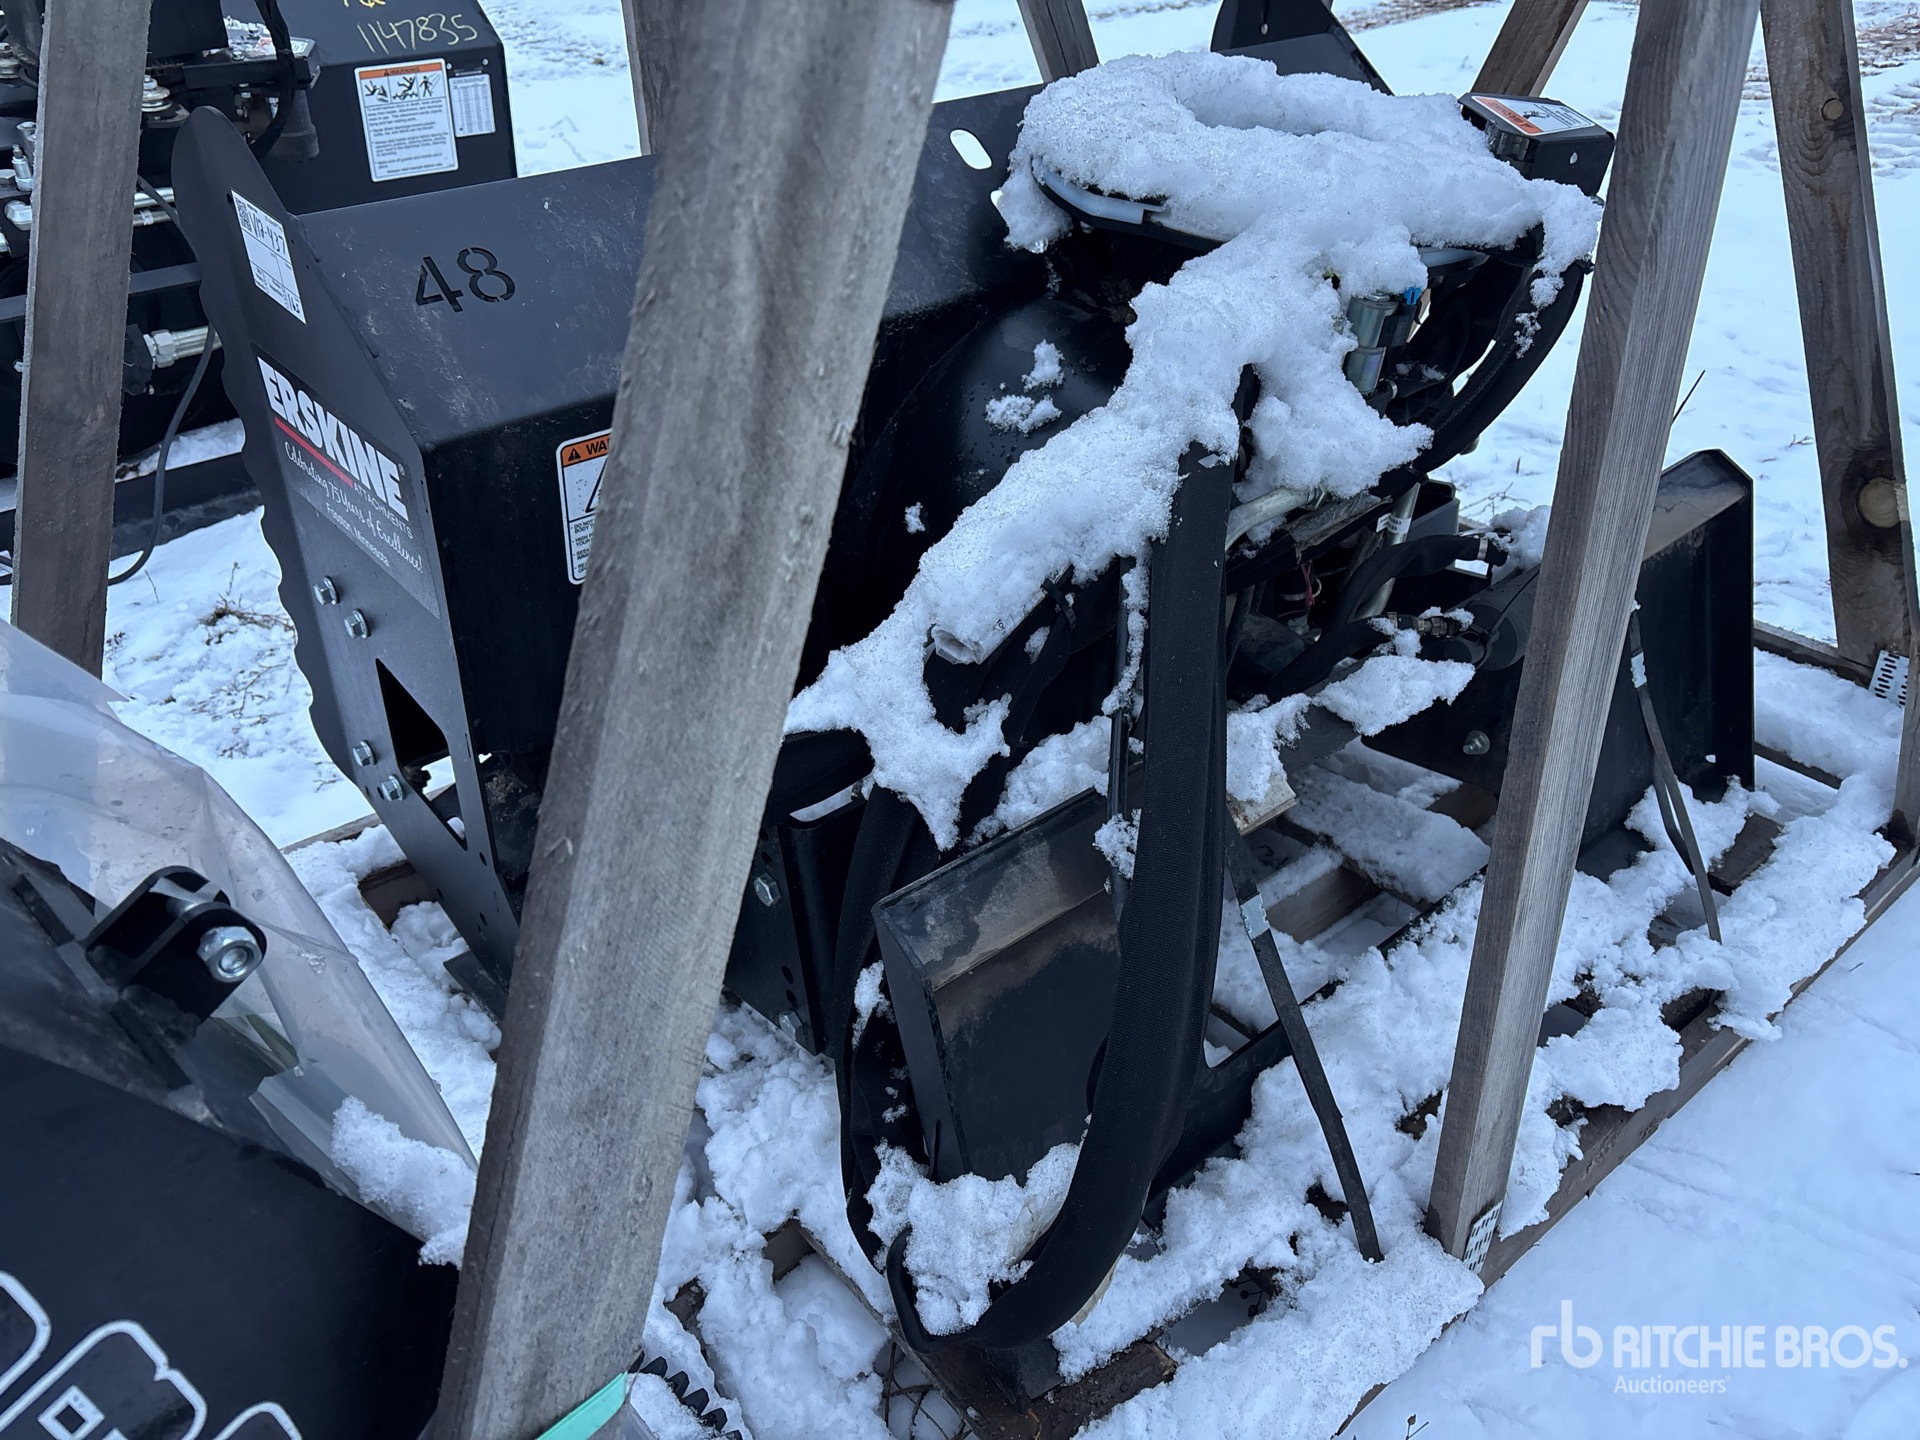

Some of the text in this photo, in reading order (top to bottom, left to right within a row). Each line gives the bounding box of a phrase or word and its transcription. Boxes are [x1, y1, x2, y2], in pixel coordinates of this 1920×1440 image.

[356, 13, 478, 54] 1147835
[415, 247, 516, 313] 48
[256, 356, 409, 522] ERSKINE
[284, 441, 330, 498] Celebrating
[328, 481, 342, 504] 75
[339, 488, 367, 524] Years
[366, 510, 377, 538] of
[354, 482, 414, 540] ATTACHMENTS
[353, 526, 391, 568] Minnesota
